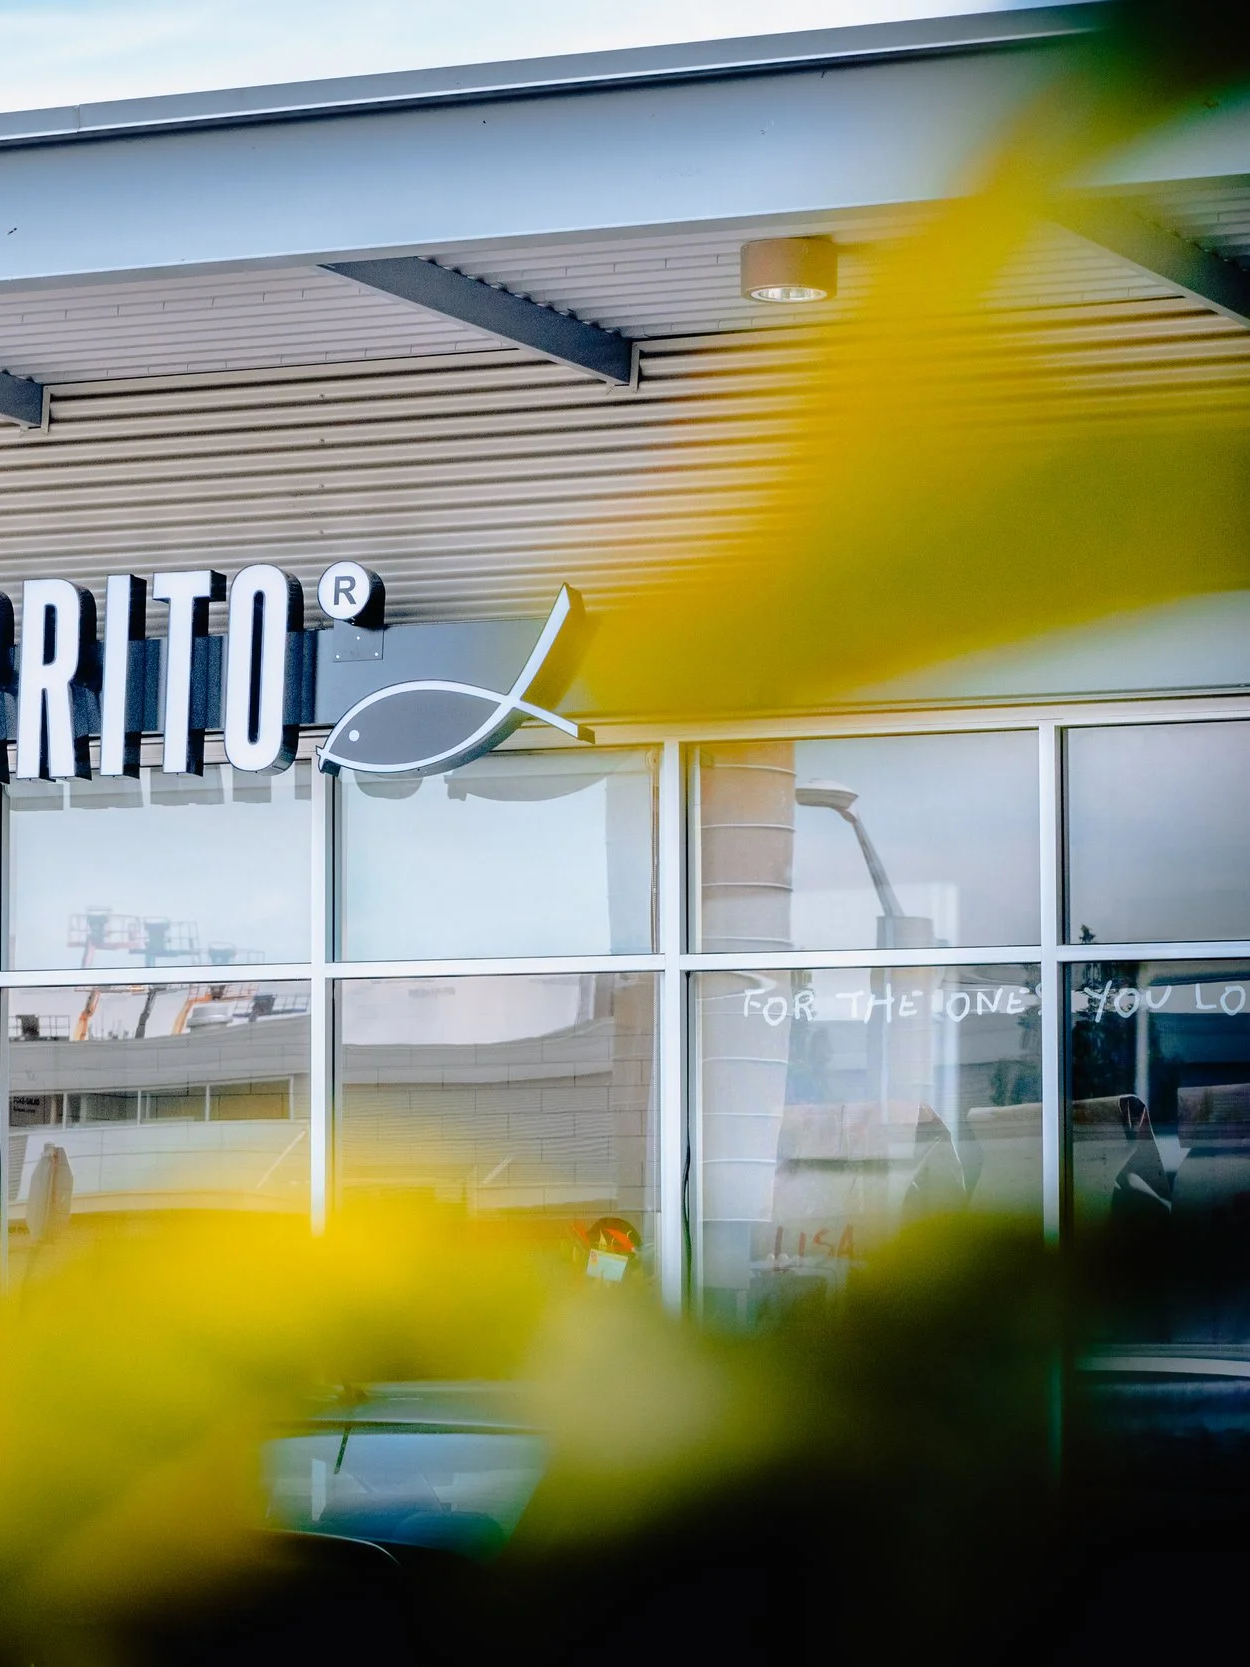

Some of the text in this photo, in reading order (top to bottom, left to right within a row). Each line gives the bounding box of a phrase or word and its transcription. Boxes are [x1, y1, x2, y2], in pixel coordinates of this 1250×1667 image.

[743, 988, 815, 1026] FOR
[836, 983, 923, 1024] THE
[1083, 980, 1172, 1023] YOU
